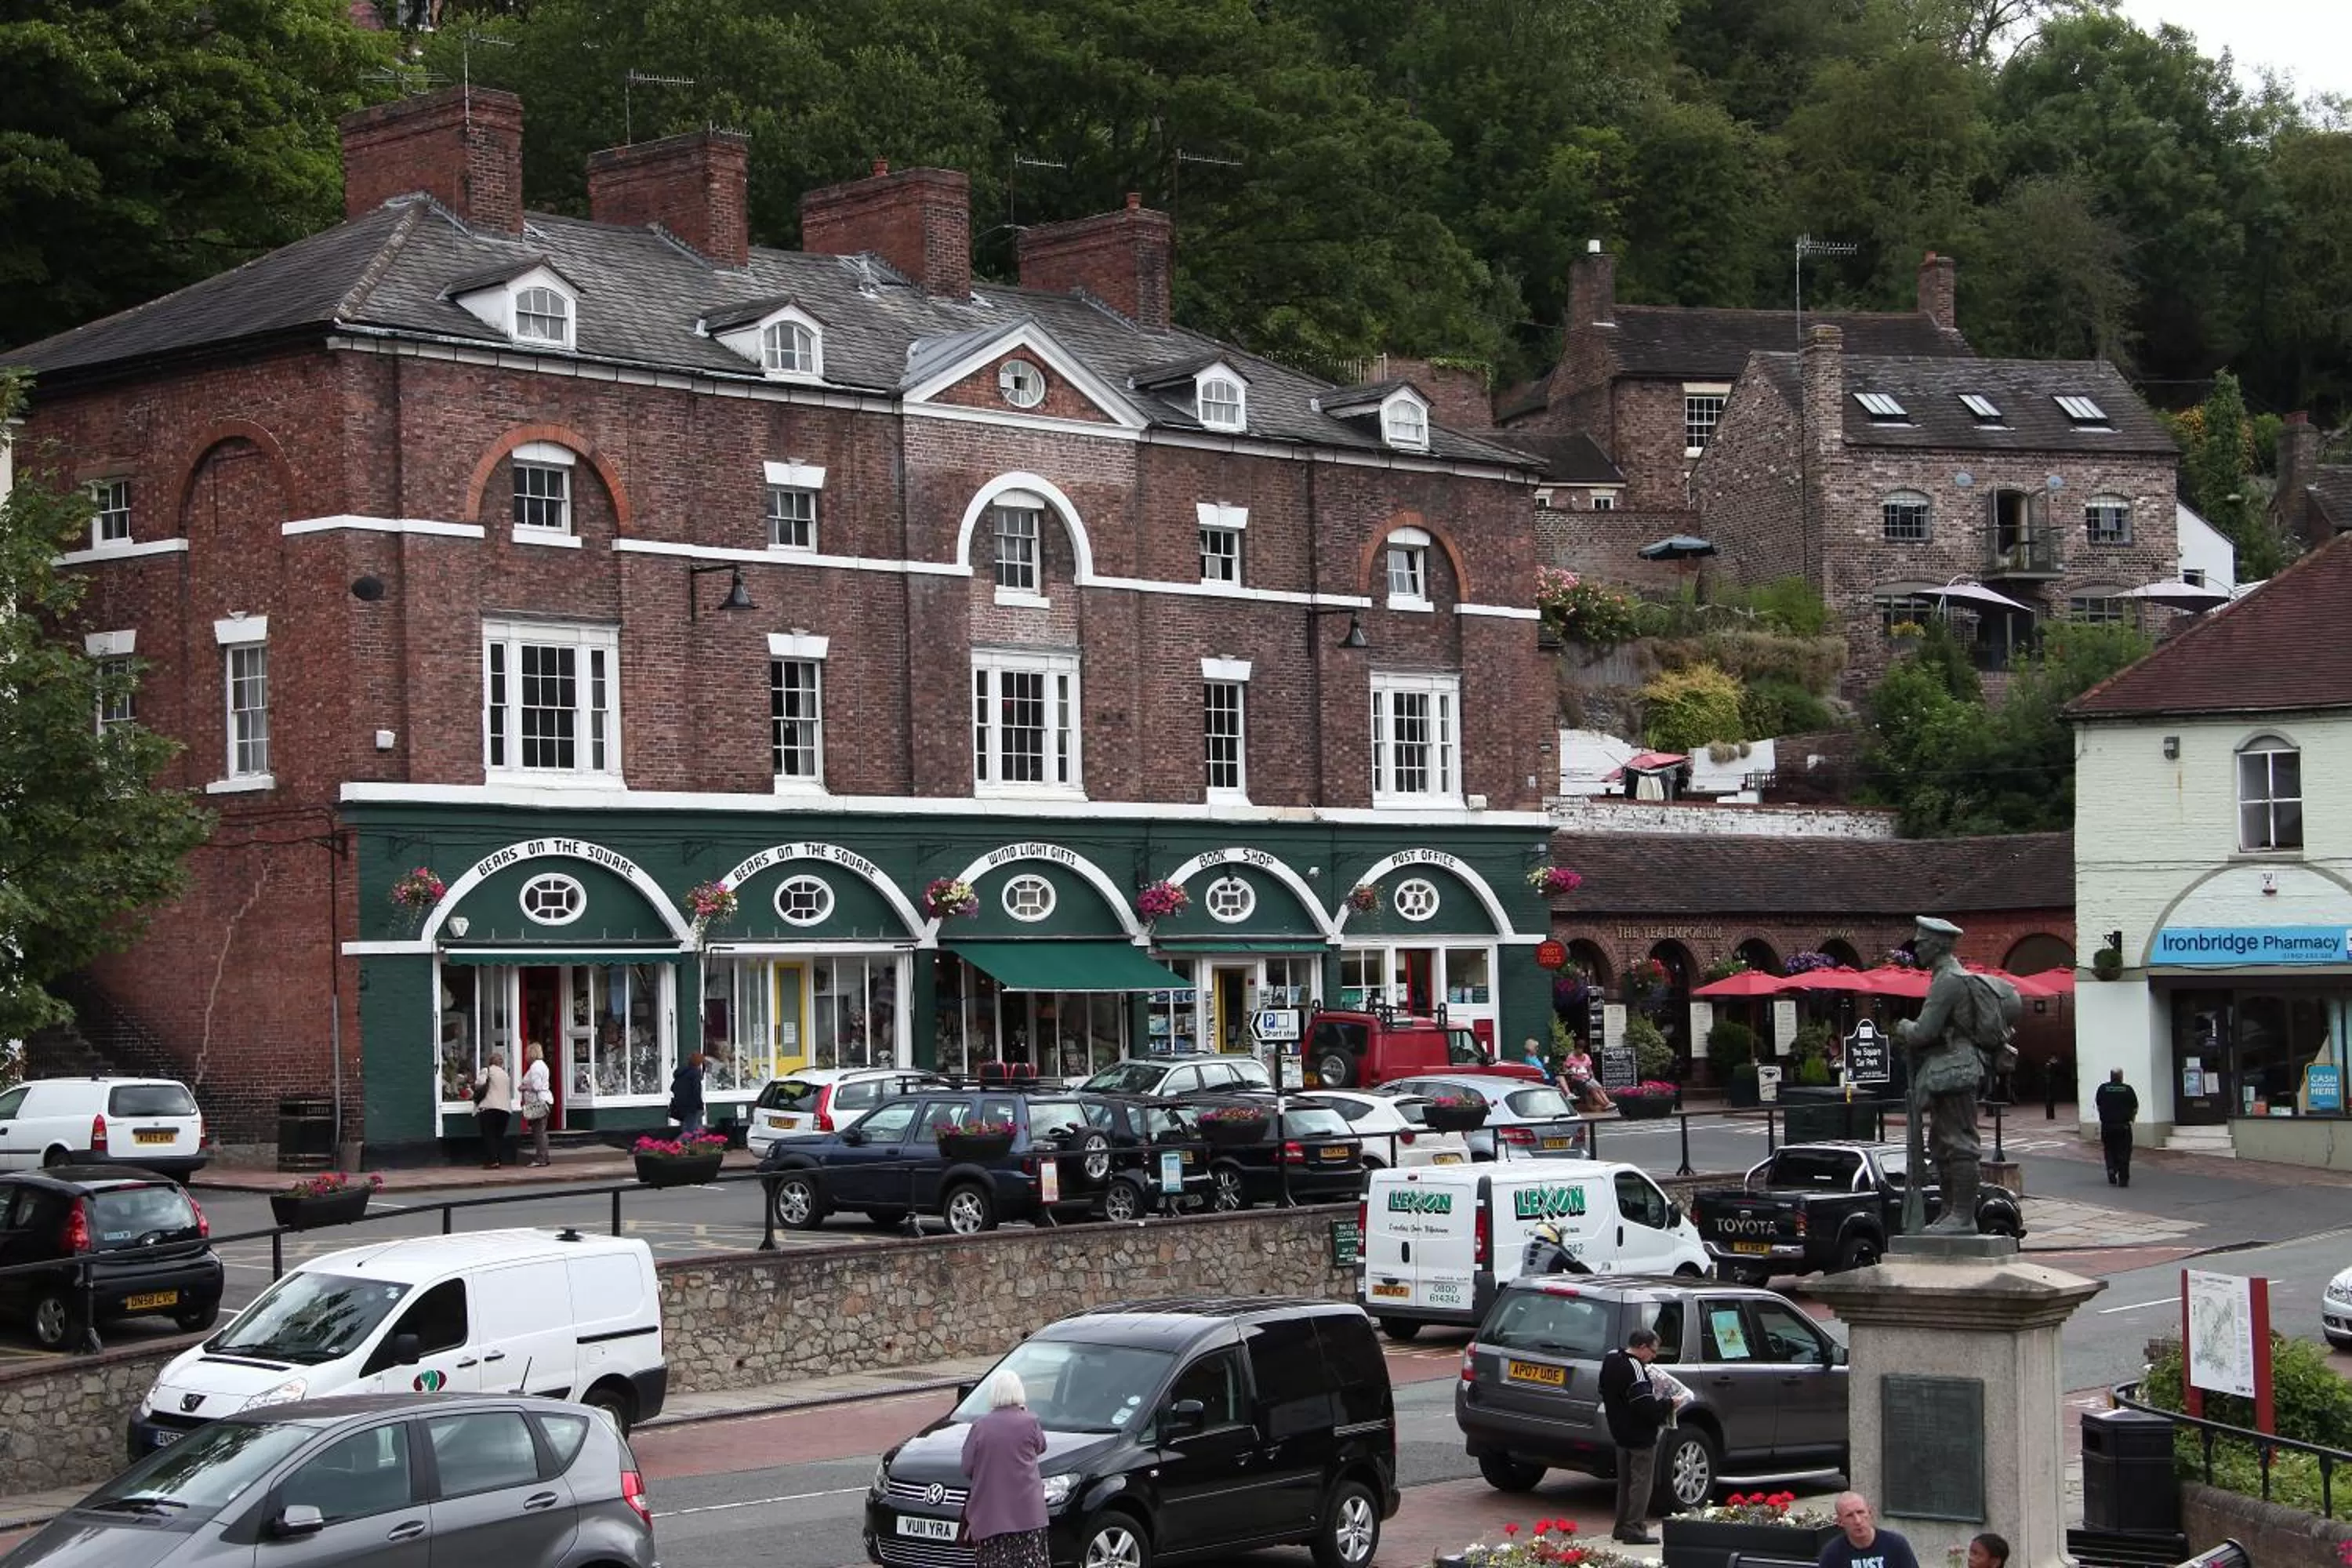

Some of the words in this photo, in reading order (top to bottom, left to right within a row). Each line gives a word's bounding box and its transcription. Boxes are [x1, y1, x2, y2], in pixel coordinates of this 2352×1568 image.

[477, 848, 518, 876] BEARS
[554, 840, 579, 854] THE
[587, 846, 636, 877] SQUARE
[734, 852, 769, 881] BEARS
[804, 843, 829, 857] THE
[834, 848, 879, 880] SQUARE
[988, 846, 1016, 865] WIND
[1019, 844, 1047, 856] LIGHT
[1051, 846, 1076, 865] GIFTS
[1199, 849, 1227, 868] BOOK
[1243, 849, 1274, 867] SHOP
[1392, 851, 1416, 866] POST
[1421, 849, 1455, 867] OFFICE
[1617, 926, 1639, 938] THE
[1542, 947, 1559, 956] POST
[2163, 933, 2259, 954] Ironbridge
[2263, 935, 2340, 952] Pharmacy
[1852, 1047, 1862, 1056] The
[2310, 1074, 2337, 1083] CASH
[1388, 1190, 1453, 1214] LEXON
[1514, 1185, 1586, 1220] LEXON
[1715, 1218, 1778, 1235] TOYOTA
[1434, 1284, 1457, 1294] 0800
[1512, 1363, 1538, 1377] AP07
[1540, 1367, 1559, 1382] UDE
[929, 1522, 951, 1537] YRA
